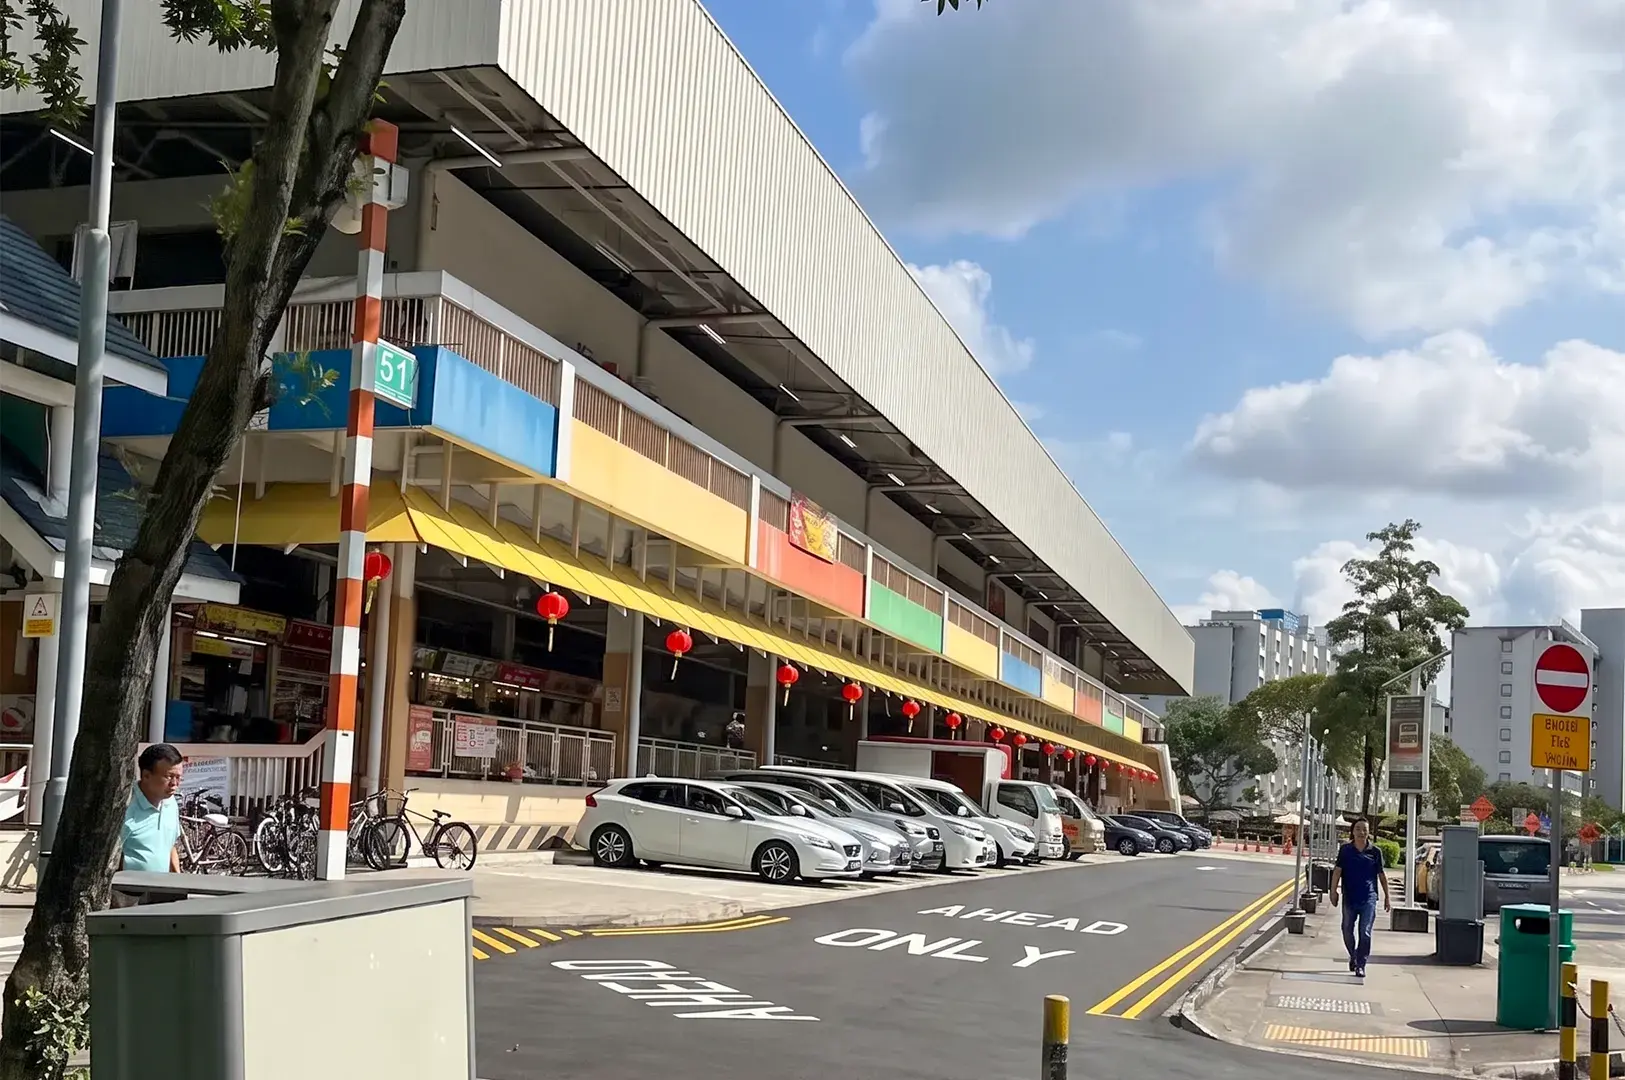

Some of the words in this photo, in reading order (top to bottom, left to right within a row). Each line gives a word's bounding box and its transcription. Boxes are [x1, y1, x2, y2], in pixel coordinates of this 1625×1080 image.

[380, 349, 407, 392] 51
[917, 904, 1129, 935] AHEAD
[550, 959, 821, 1021] AHEAD
